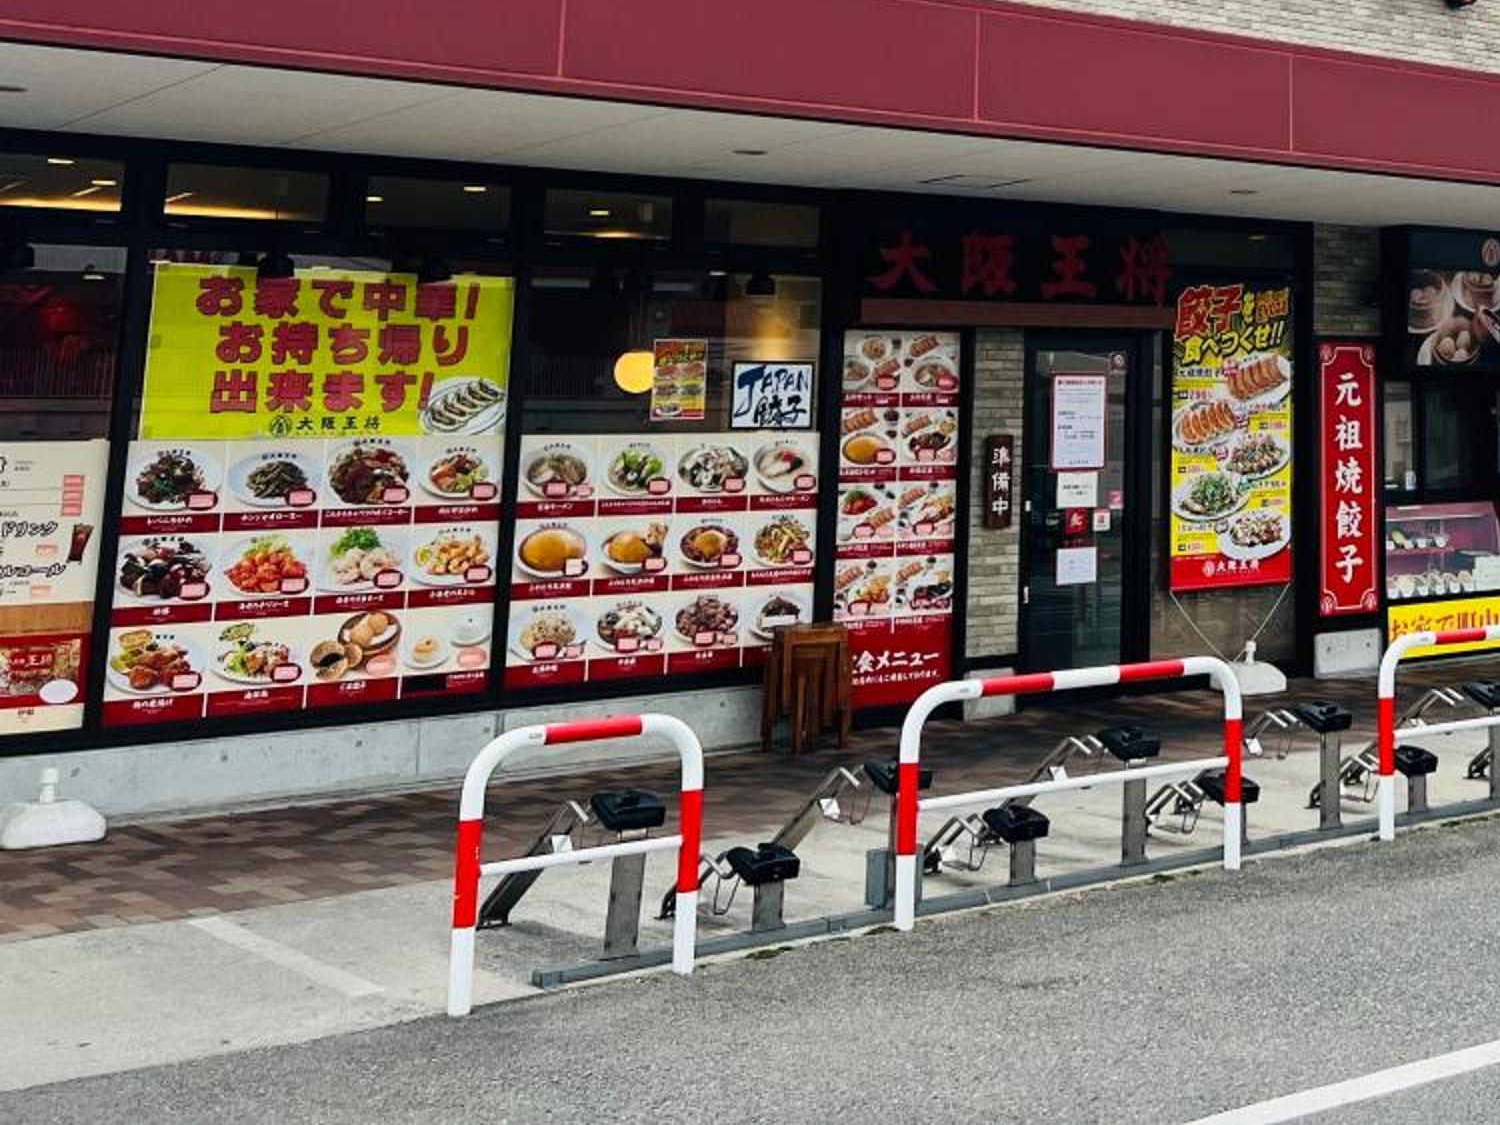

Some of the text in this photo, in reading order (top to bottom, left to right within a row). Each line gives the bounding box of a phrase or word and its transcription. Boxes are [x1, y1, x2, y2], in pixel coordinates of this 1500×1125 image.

[868, 228, 1173, 306] 大阪王将
[215, 322, 468, 367] お持ち帰り
